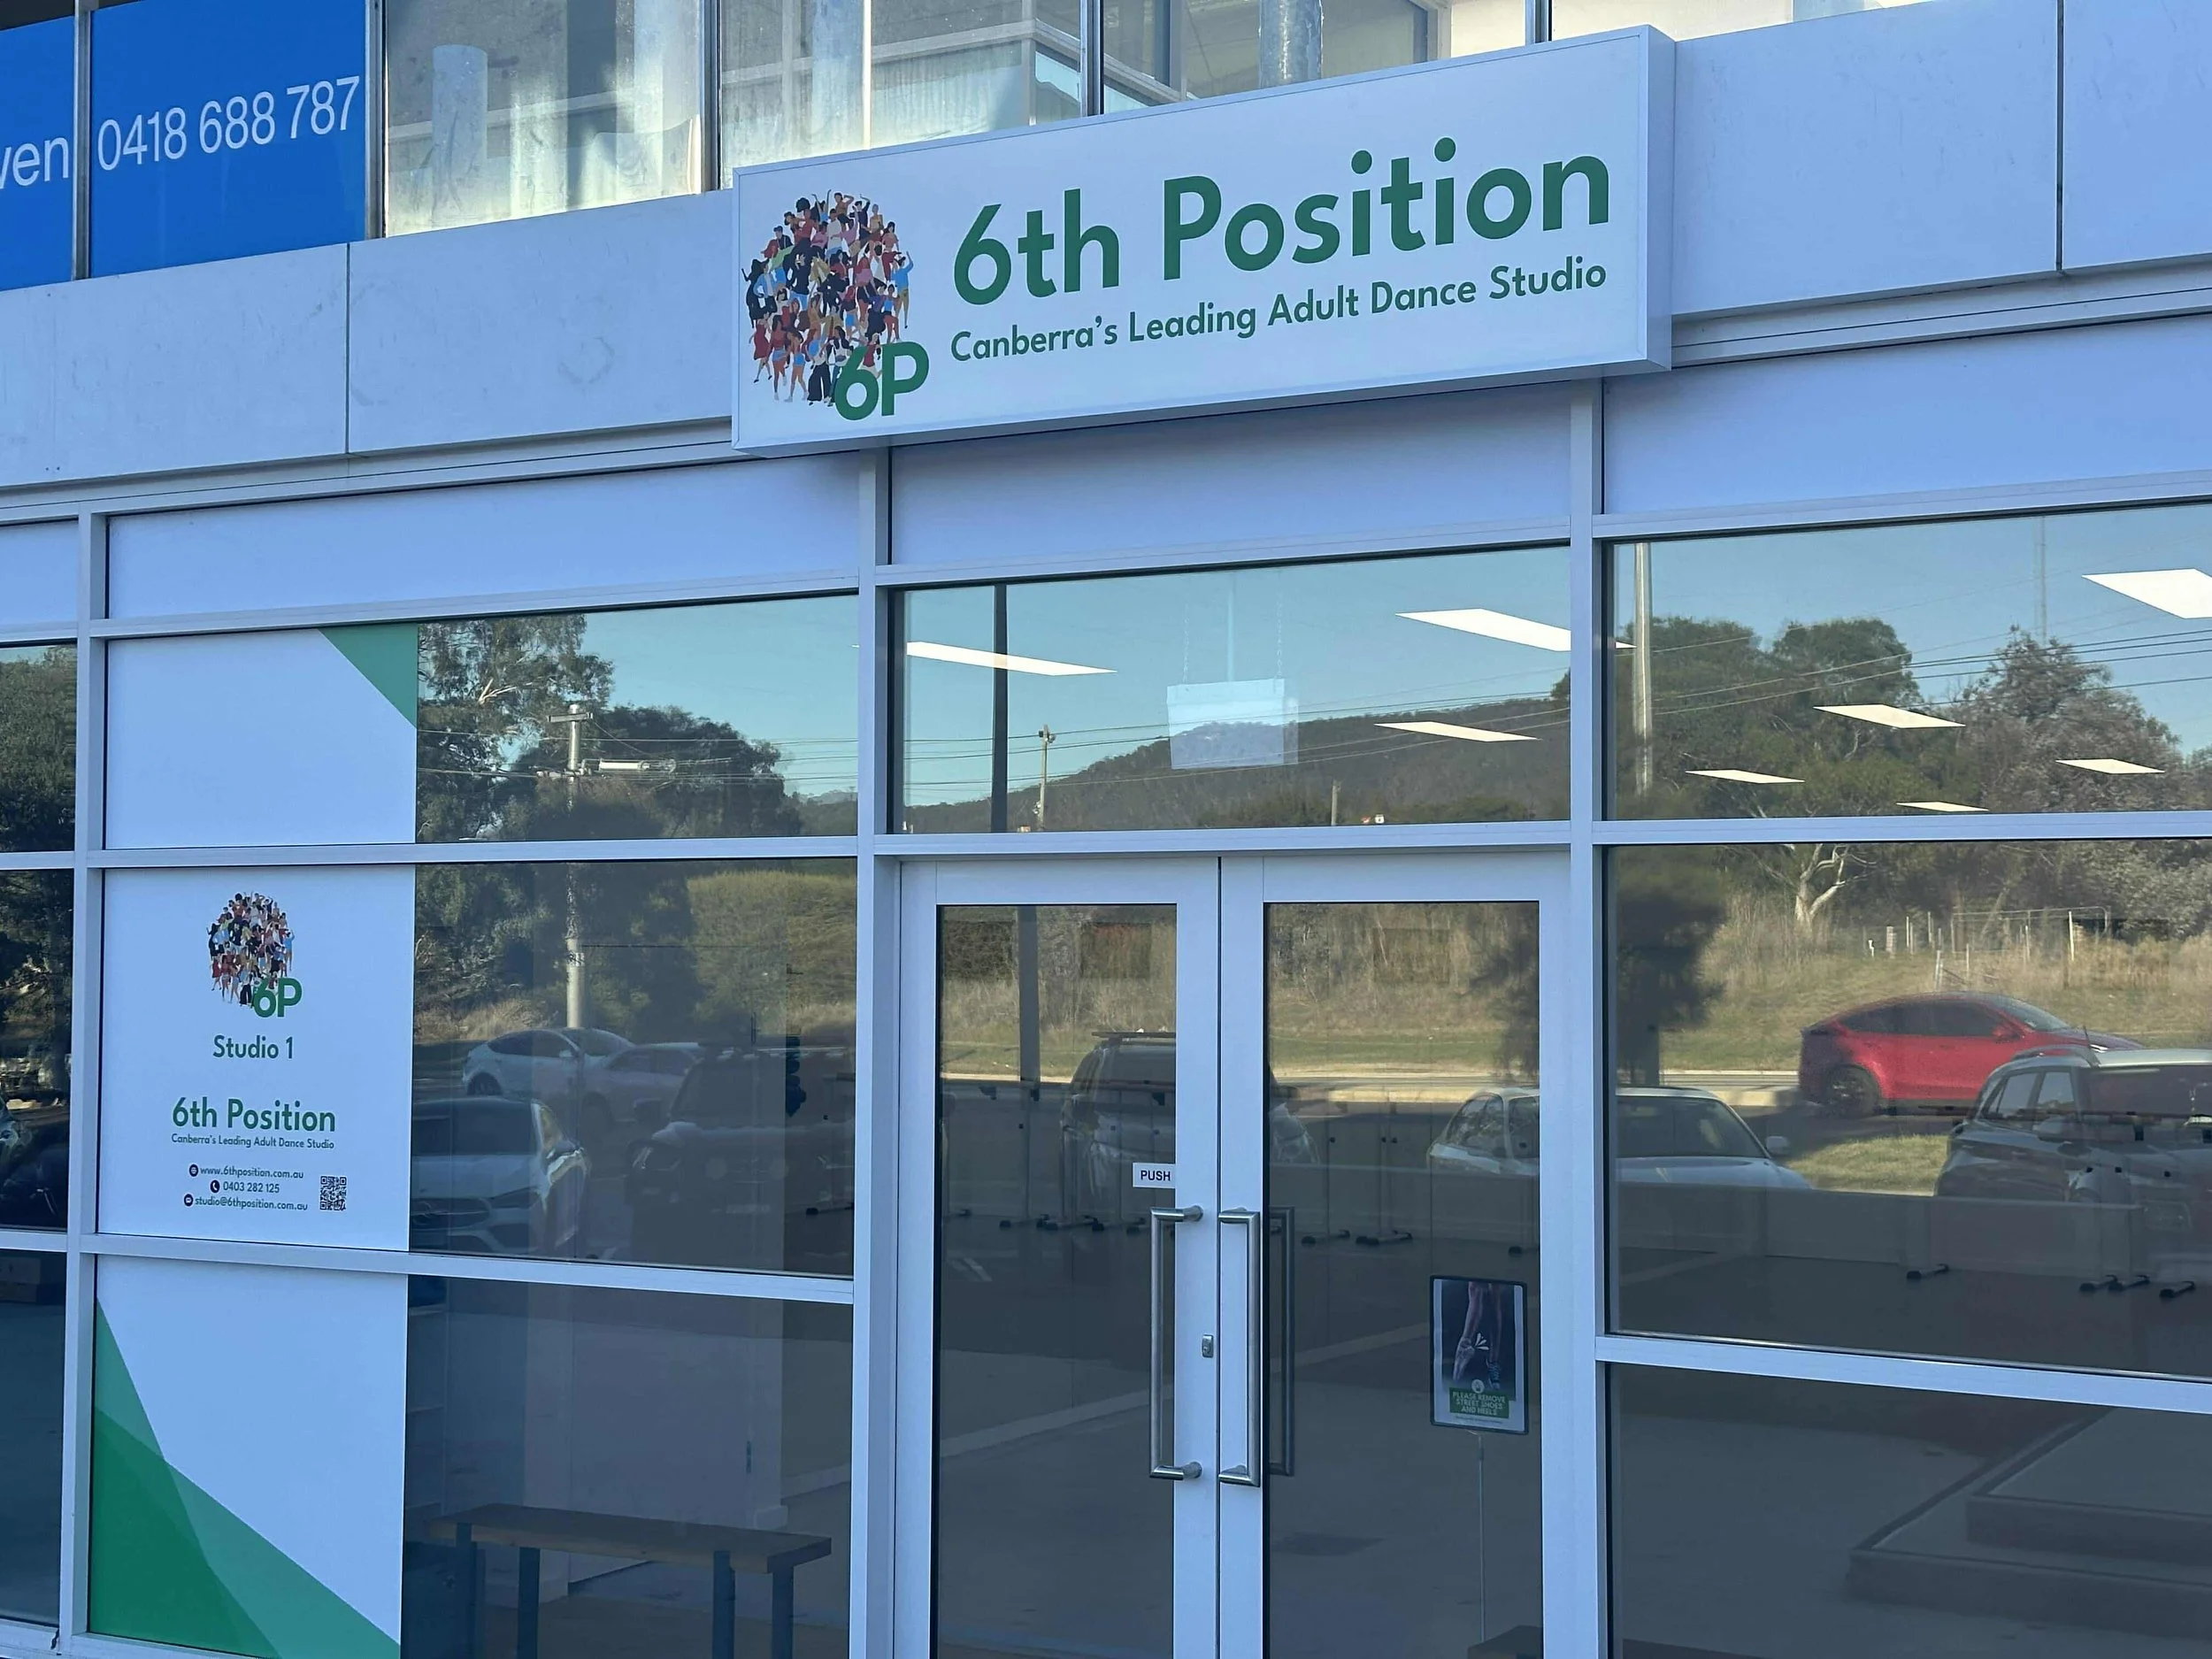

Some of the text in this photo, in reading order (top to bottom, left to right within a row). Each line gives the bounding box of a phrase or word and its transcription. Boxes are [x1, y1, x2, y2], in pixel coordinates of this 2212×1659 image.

[97, 107, 187, 171] 0418
[199, 91, 275, 154] 688
[287, 75, 360, 139] 787
[953, 136, 1610, 306] 6th Position
[1129, 301, 1256, 342] Leading
[1267, 284, 1360, 326] Adult
[1371, 280, 1477, 314] Dance
[1488, 255, 1607, 300] Studio
[833, 342, 930, 421] 6P
[252, 976, 303, 1018] 6P
[212, 1034, 293, 1059] Studio 1
[173, 1096, 335, 1132] 6th Position
[218, 1134, 251, 1148] Leading
[253, 1136, 277, 1148] Adult
[278, 1137, 305, 1148] Dance
[306, 1138, 334, 1149] Studio
[200, 1165, 304, 1179] www.6thposition.com.au
[1141, 1170, 1171, 1181] PUSH
[223, 1181, 280, 1194] 0403 282 125
[195, 1194, 309, 1211] studio@6thposition.com.au
[1452, 1391, 1506, 1403] PLEASE REMOVE
